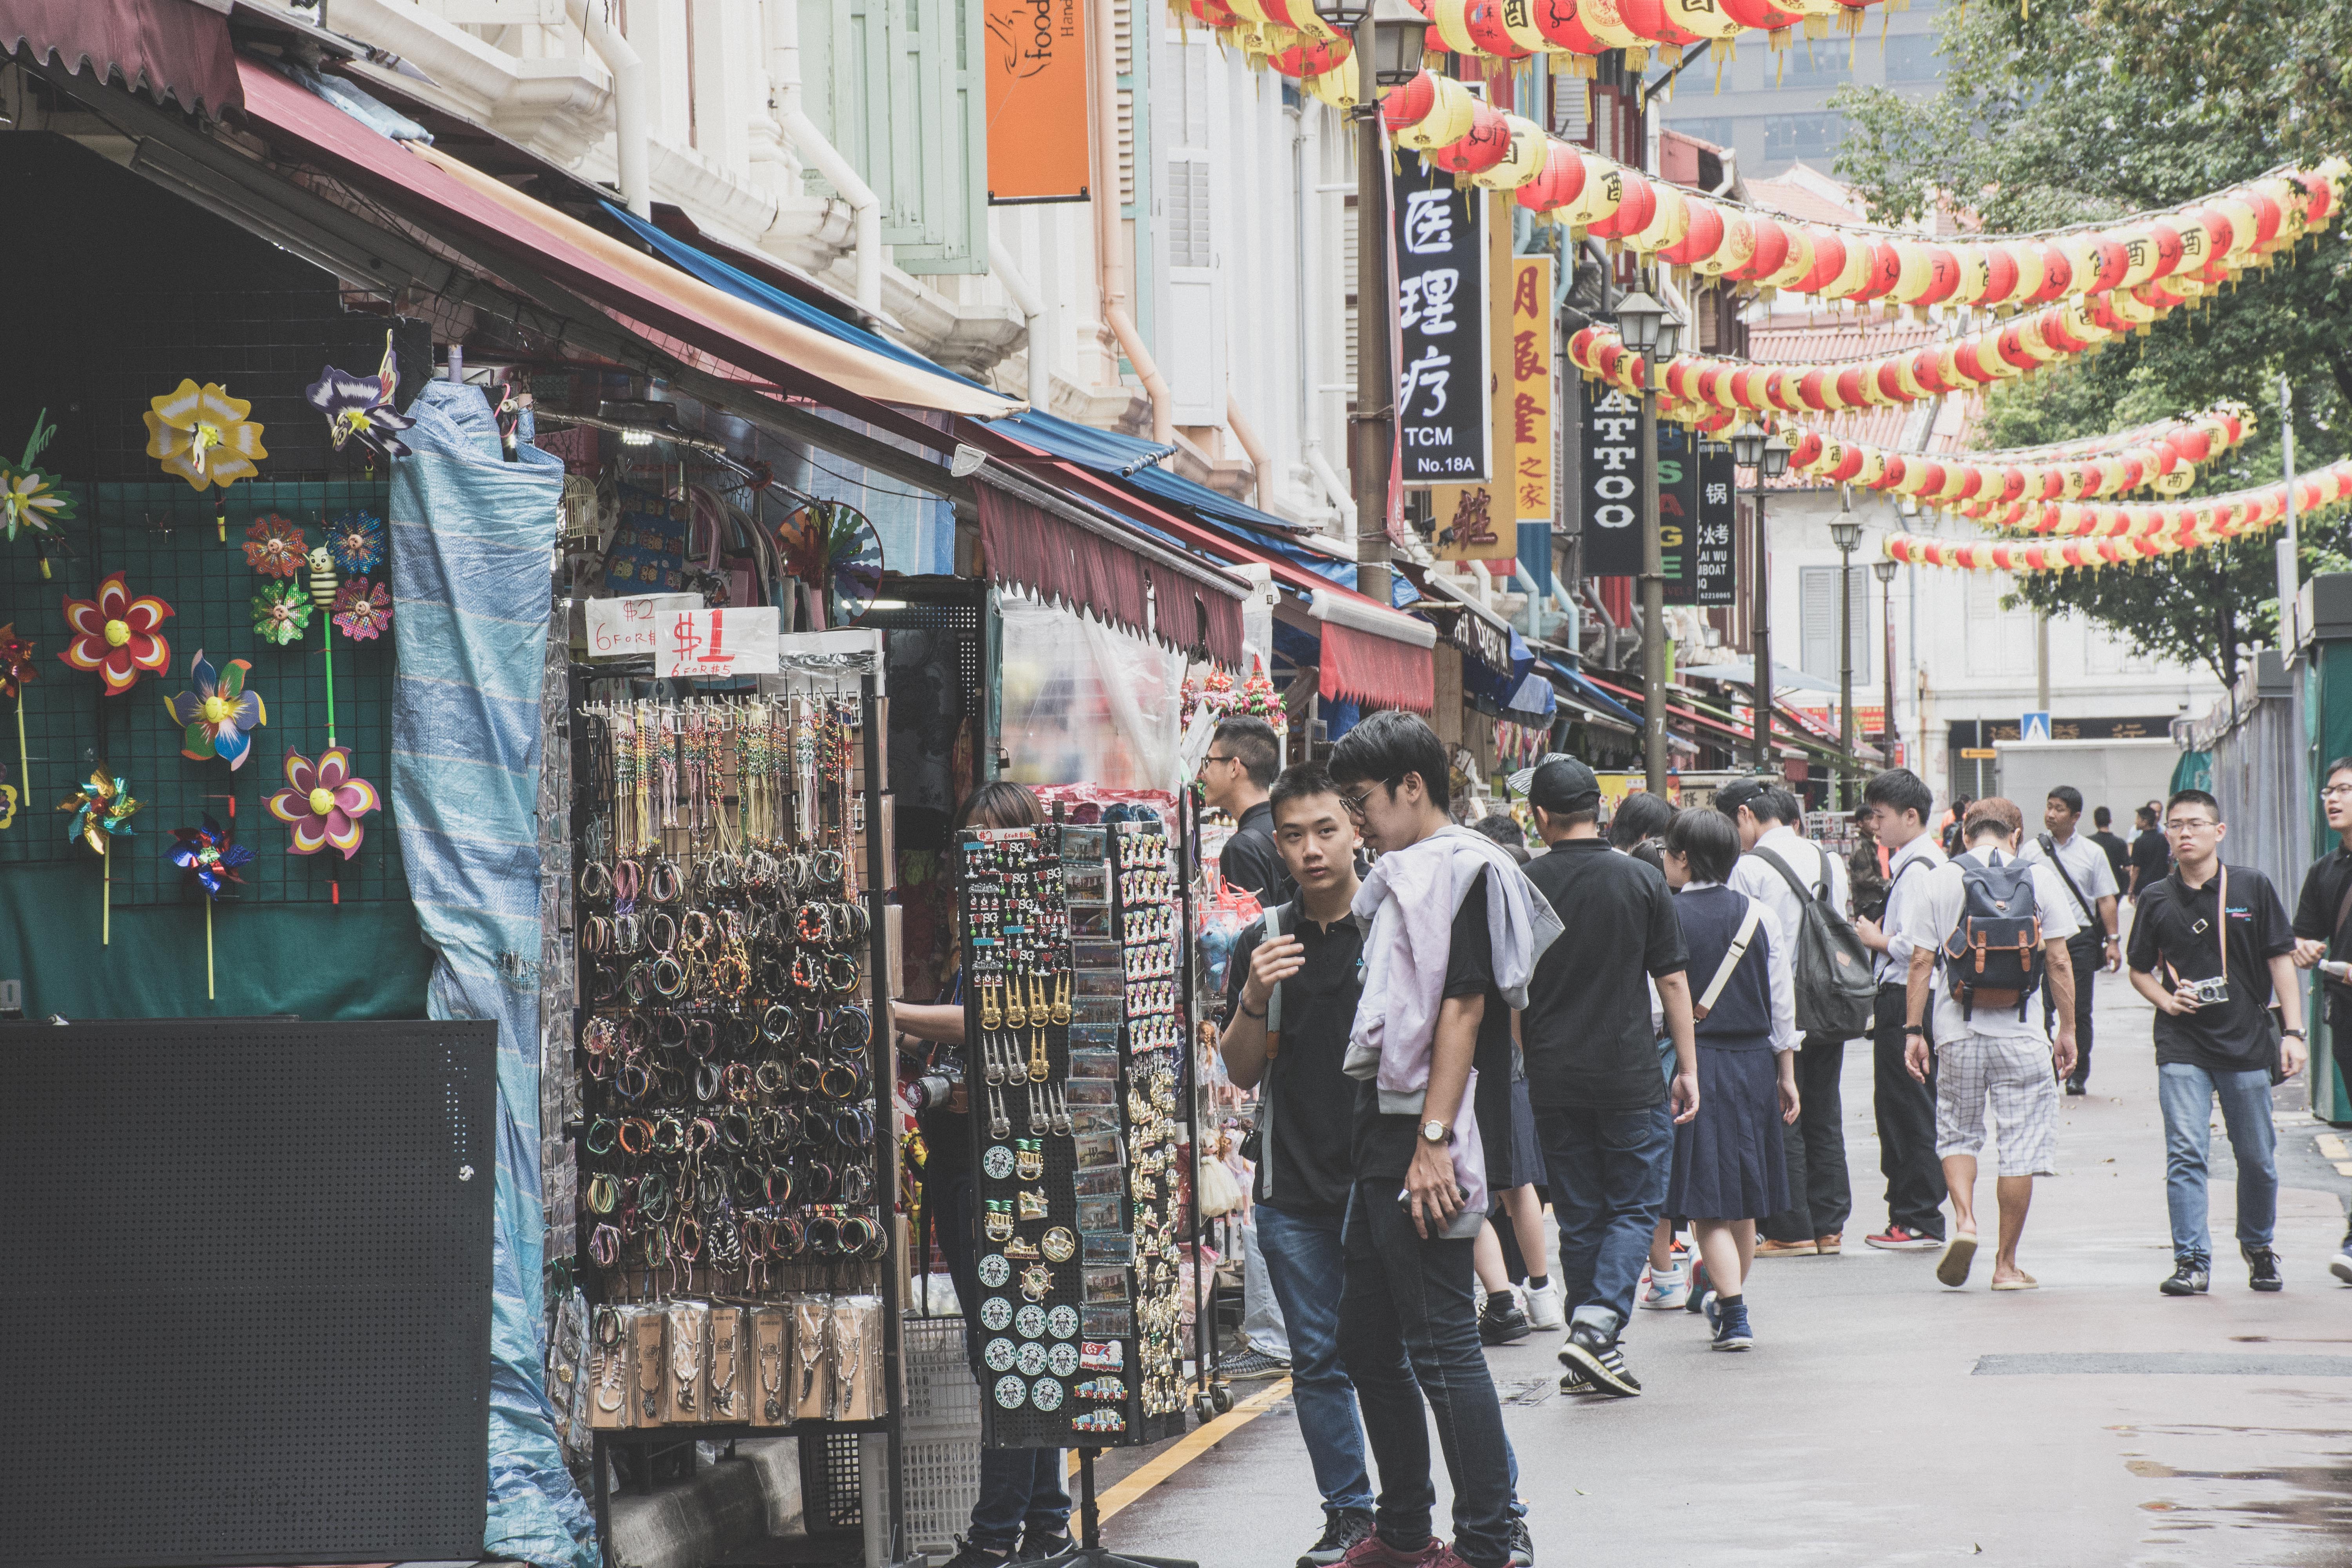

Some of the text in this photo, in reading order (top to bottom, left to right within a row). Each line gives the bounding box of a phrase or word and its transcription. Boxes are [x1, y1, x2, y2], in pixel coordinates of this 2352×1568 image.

[1400, 172, 1459, 417] 医理疗
[1405, 427, 1452, 446] TCM
[1418, 457, 1475, 472] No.18A
[1713, 550, 1727, 561] WU
[623, 600, 655, 622] $2
[671, 608, 735, 662] $1
[1655, 717, 1663, 735] 7
[979, 831, 994, 840] $2
[1009, 842, 1025, 853] SG
[1012, 873, 1028, 884] SG
[1047, 867, 1062, 879] SG
[1019, 898, 1034, 910] SG
[983, 912, 999, 923] SG
[1019, 950, 1036, 961] SG
[986, 1148, 1013, 1165] SINGAPORE
[985, 1165, 1010, 1178] MERLION
[980, 1255, 1009, 1271] SINGAPORE
[982, 1276, 1007, 1287] MERLION
[983, 1298, 1011, 1313] SINGAPORE
[1017, 1306, 1045, 1321] SINGAPORE
[1048, 1307, 1076, 1321] SINGAPORE
[985, 1318, 1010, 1330] MERLION
[1020, 1325, 1045, 1338] MERLION
[1051, 1326, 1076, 1338] MERLION
[986, 1339, 1014, 1356] SINGAPORE
[1020, 1343, 1047, 1362] SINGAPORE
[1049, 1344, 1077, 1358] SINGAPORE
[991, 1356, 1015, 1370] MERLION
[1017, 1360, 1041, 1374] MERLION
[1051, 1365, 1076, 1376] MERLION
[996, 1377, 1024, 1392] SINGAPORE
[1035, 1379, 1062, 1399] SINGAPORE
[1000, 1395, 1025, 1408] MERLION
[1033, 1396, 1058, 1410] MERLION
